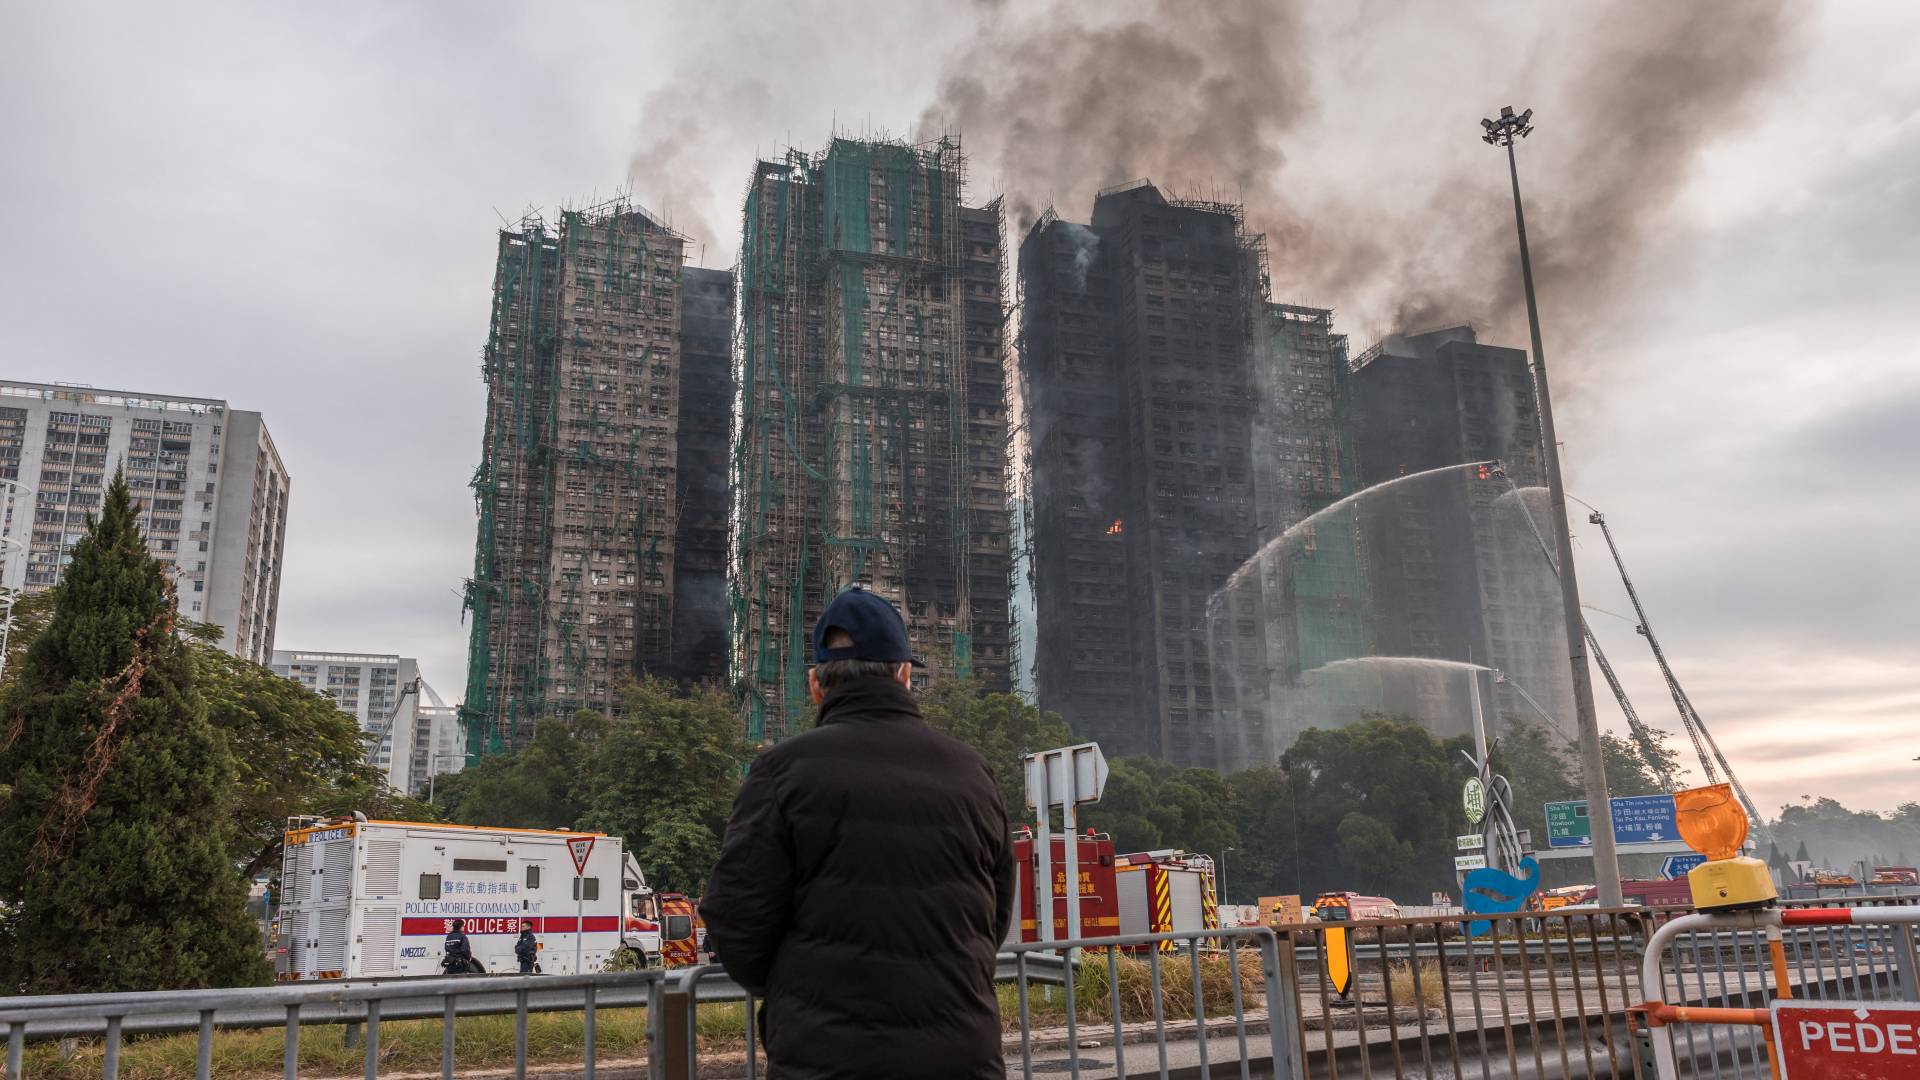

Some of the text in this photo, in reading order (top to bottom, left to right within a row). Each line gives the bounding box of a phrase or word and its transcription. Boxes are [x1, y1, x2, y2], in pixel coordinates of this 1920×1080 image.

[314, 829, 342, 843] POLICE
[444, 880, 519, 894] 警察流動指揮車
[405, 902, 541, 914] POLICE MOBILE COMMAND UNIT
[506, 918, 518, 934] 察
[1798, 1020, 1920, 1056] PEDE
